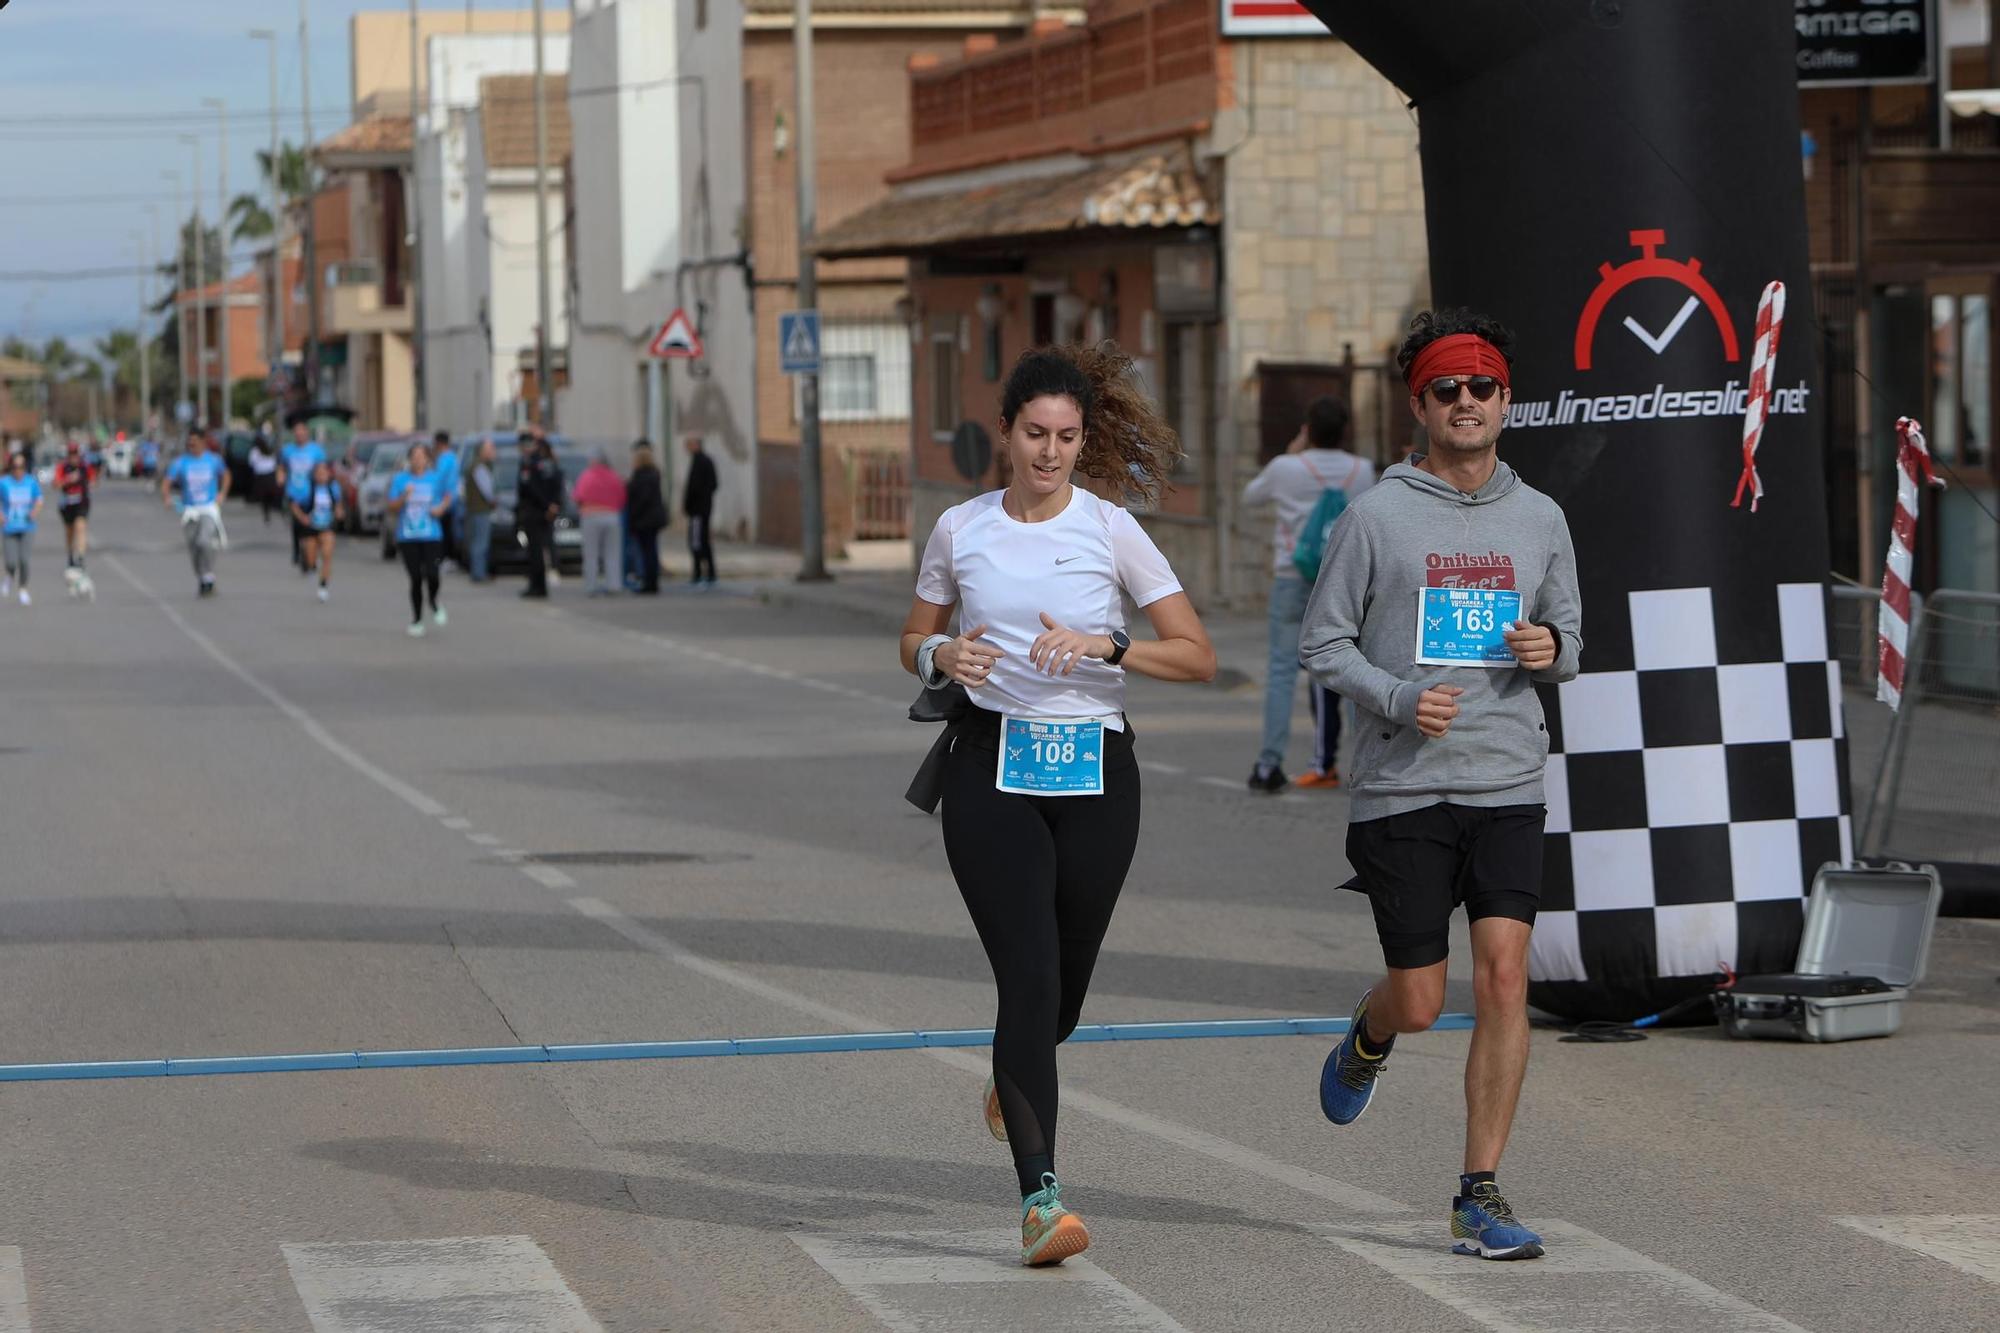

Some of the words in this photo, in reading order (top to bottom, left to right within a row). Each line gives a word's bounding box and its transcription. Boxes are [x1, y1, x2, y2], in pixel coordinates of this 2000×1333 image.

[1503, 380, 1810, 428] ww.lineadesali.net
[1426, 551, 1513, 568] Onitsuka
[1452, 608, 1494, 631] 163
[1031, 741, 1075, 763] 108
